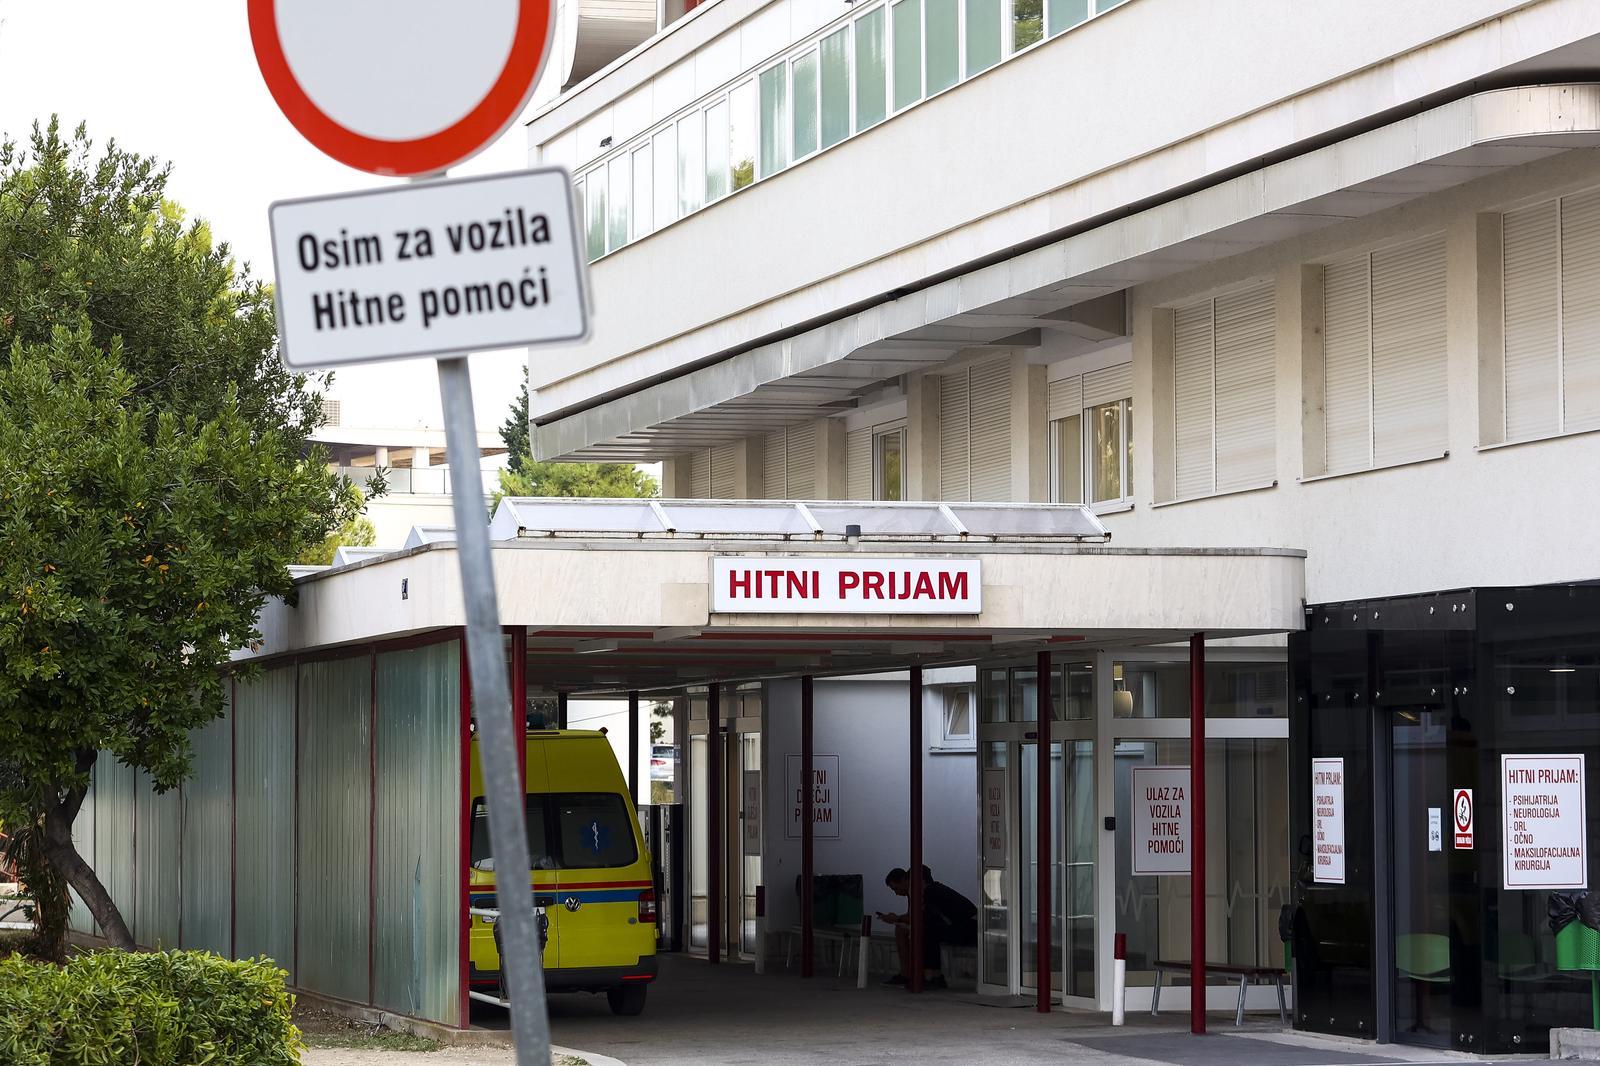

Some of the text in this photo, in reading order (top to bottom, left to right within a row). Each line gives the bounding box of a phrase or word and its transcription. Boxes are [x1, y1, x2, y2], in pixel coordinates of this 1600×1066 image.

[298, 207, 552, 272] Osim za vozila
[312, 267, 550, 331] Hitne pomoći
[729, 570, 968, 600] HITNI PRIJAM
[1508, 769, 1579, 784] HITNI PRIJAM:
[1146, 787, 1185, 801] ULAZ ZA
[1513, 795, 1558, 806] PSIHIJATRIJA
[1150, 804, 1181, 818] VOZILA
[1513, 808, 1560, 819] NEUROLOGIJA
[1152, 822, 1179, 836] HITNE
[1513, 821, 1527, 831] ORL
[1148, 836, 1184, 854] POMOĆI
[1514, 832, 1533, 844] OČNO
[1514, 847, 1580, 858] MAKSILOFACIJALNA
[1514, 860, 1551, 871] KIRURGIJA
